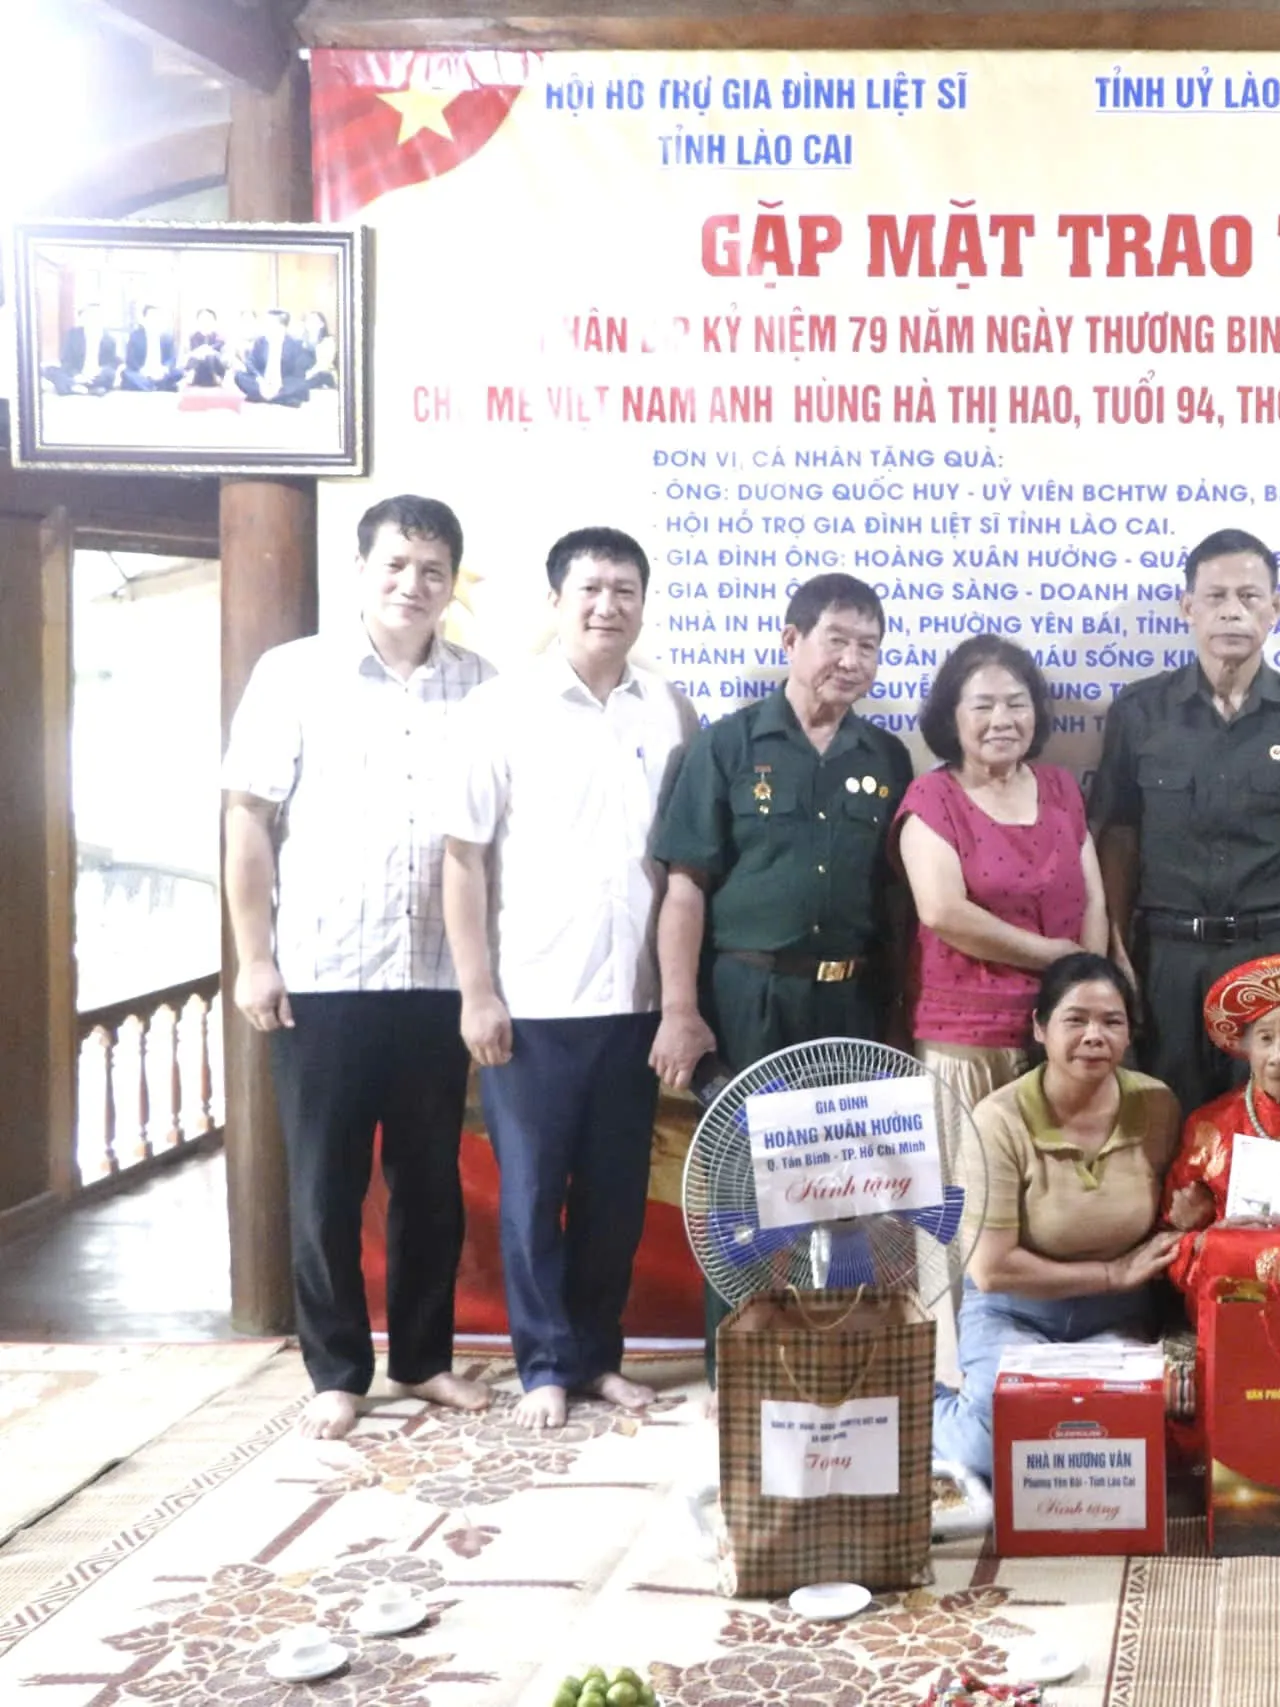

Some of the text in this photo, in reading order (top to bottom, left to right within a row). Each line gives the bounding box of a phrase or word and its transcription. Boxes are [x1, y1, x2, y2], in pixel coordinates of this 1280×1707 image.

[659, 75, 712, 116] TRỢ
[722, 79, 772, 110] GIA
[782, 70, 856, 110] ĐÌNH
[866, 71, 926, 117] LIỆT
[937, 72, 968, 110] SĨ
[1096, 66, 1165, 110] TỈNH
[1175, 66, 1212, 110] UỶ
[1224, 71, 1280, 110] LÀO
[658, 125, 853, 166] TỈNH LÀO CAI
[701, 200, 842, 290] GẶP
[867, 199, 1035, 290] MẶT
[1057, 214, 1253, 278] TRAO
[703, 302, 742, 354] KỶ
[754, 306, 836, 362] NIỆM
[848, 316, 887, 354] 79
[899, 307, 974, 354] NĂM
[986, 306, 1074, 354] NGÀY
[1085, 313, 1216, 355] THƯƠNG
[622, 385, 696, 423] NAM
[710, 385, 773, 423] ANH
[794, 376, 881, 424] HÙNG
[893, 377, 936, 424] HÀ
[947, 385, 997, 433] THỊ
[1009, 385, 1081, 430] HAO,
[1092, 370, 1165, 424] TUỔI
[1177, 386, 1224, 428] 94,
[653, 449, 706, 468] ĐƠN
[752, 446, 786, 468] CÁ
[795, 446, 861, 468] NHÂN
[870, 445, 935, 473] TẶNG
[944, 445, 1004, 469] QUÀ:
[666, 479, 729, 501] ÔNG:
[738, 481, 824, 501] DƯƠNG
[832, 476, 904, 502] QUỐC
[913, 483, 960, 502] HUY
[983, 477, 1012, 502] UỶ
[1021, 479, 1073, 502] VIÊN
[1082, 484, 1168, 502] BCHTW
[1176, 478, 1255, 506] ĐẢNG,
[667, 509, 1176, 539] HỘI HỖ TRỢ GIA ĐÌNH LIỆT SĨ TỈNH LÀO CAI.
[667, 542, 1118, 568] GIA ĐÌNH ÔNG: HOÀNG XUÂN HƯỞNG
[668, 582, 708, 600] GIA
[717, 577, 776, 600] ĐÌNH
[870, 577, 1129, 601] OÀNG SÀNG DOANH
[669, 610, 716, 633] NHÀ
[725, 615, 748, 633] IN
[919, 611, 1022, 635] PHƯỜNG
[1030, 611, 1073, 634] YÊN
[1082, 611, 1128, 638] BÁI,
[1136, 610, 1190, 635] TỈNH
[670, 643, 745, 666] THÀNH
[1085, 641, 1155, 668] SỐNG
[720, 676, 776, 698] ĐÌNH
[815, 1095, 869, 1114] GIA ĐÌNH
[764, 1110, 923, 1149] HOÀNG XUÂN HƯỞNG
[767, 1159, 779, 1172] Q.
[841, 1148, 857, 1162] TP.
[899, 1140, 926, 1155] Minh
[1026, 1451, 1049, 1469] NHÀ
[1053, 1453, 1065, 1468] IN
[1109, 1449, 1132, 1468] VÂN
